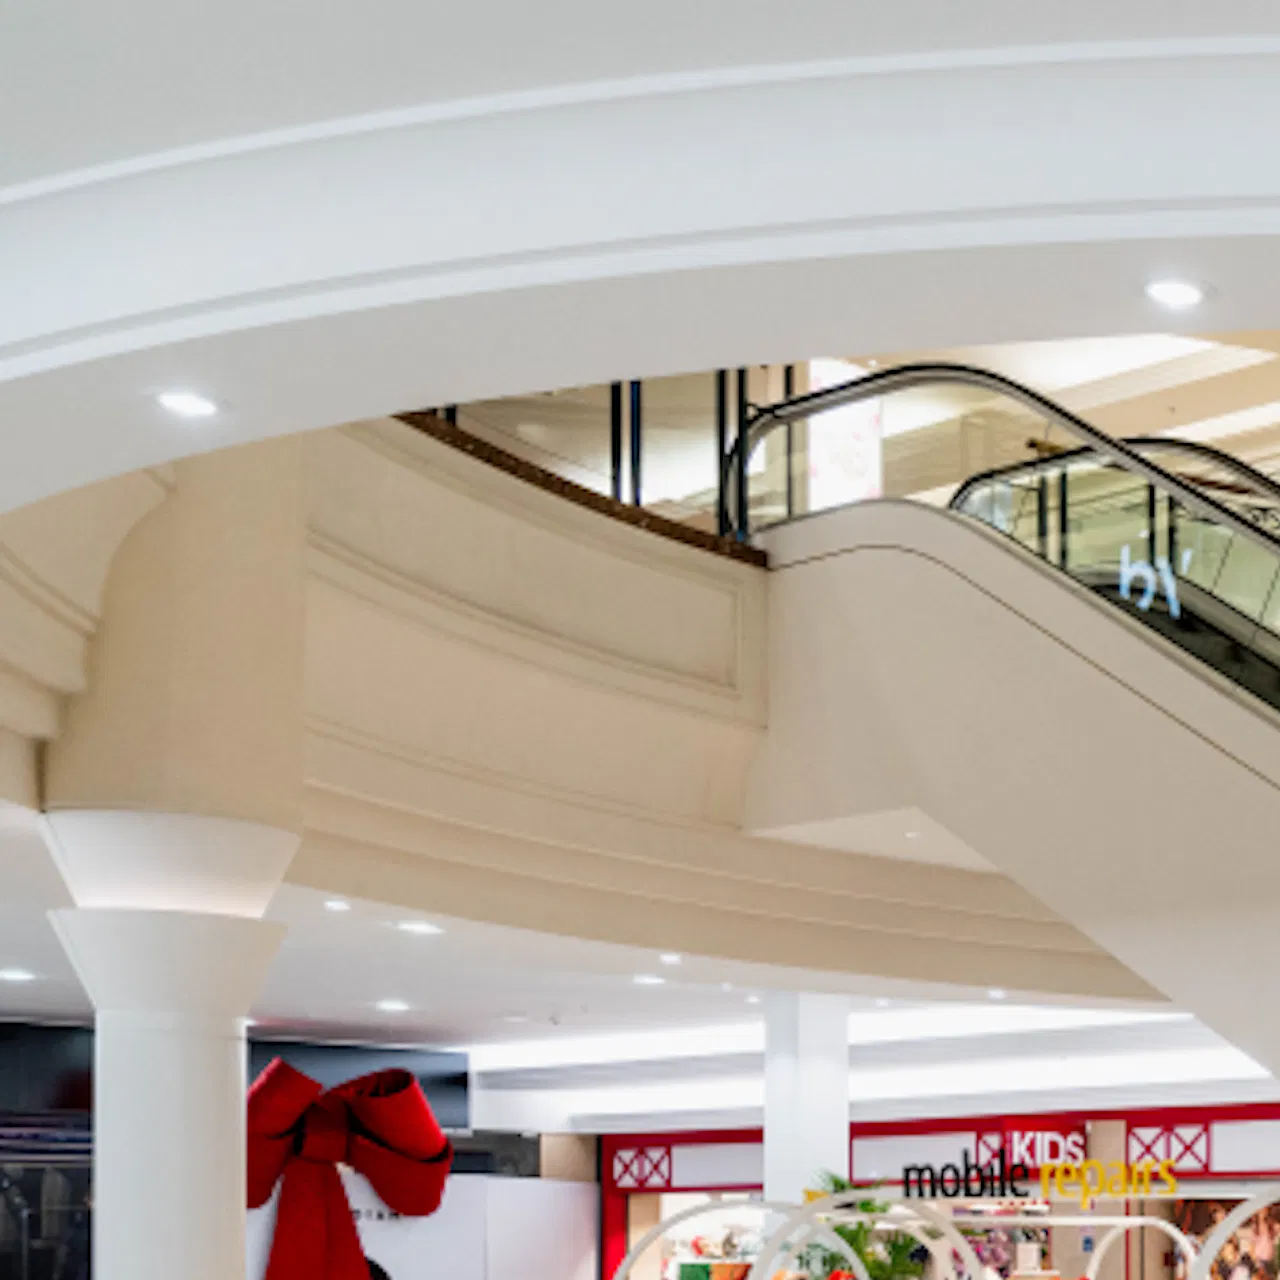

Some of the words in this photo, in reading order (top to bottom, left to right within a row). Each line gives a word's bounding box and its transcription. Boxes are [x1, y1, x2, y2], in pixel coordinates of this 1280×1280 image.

[1011, 1130, 1086, 1168] KIDS
[902, 1148, 1030, 1199] mobile
[1039, 1158, 1180, 1210] repairs
